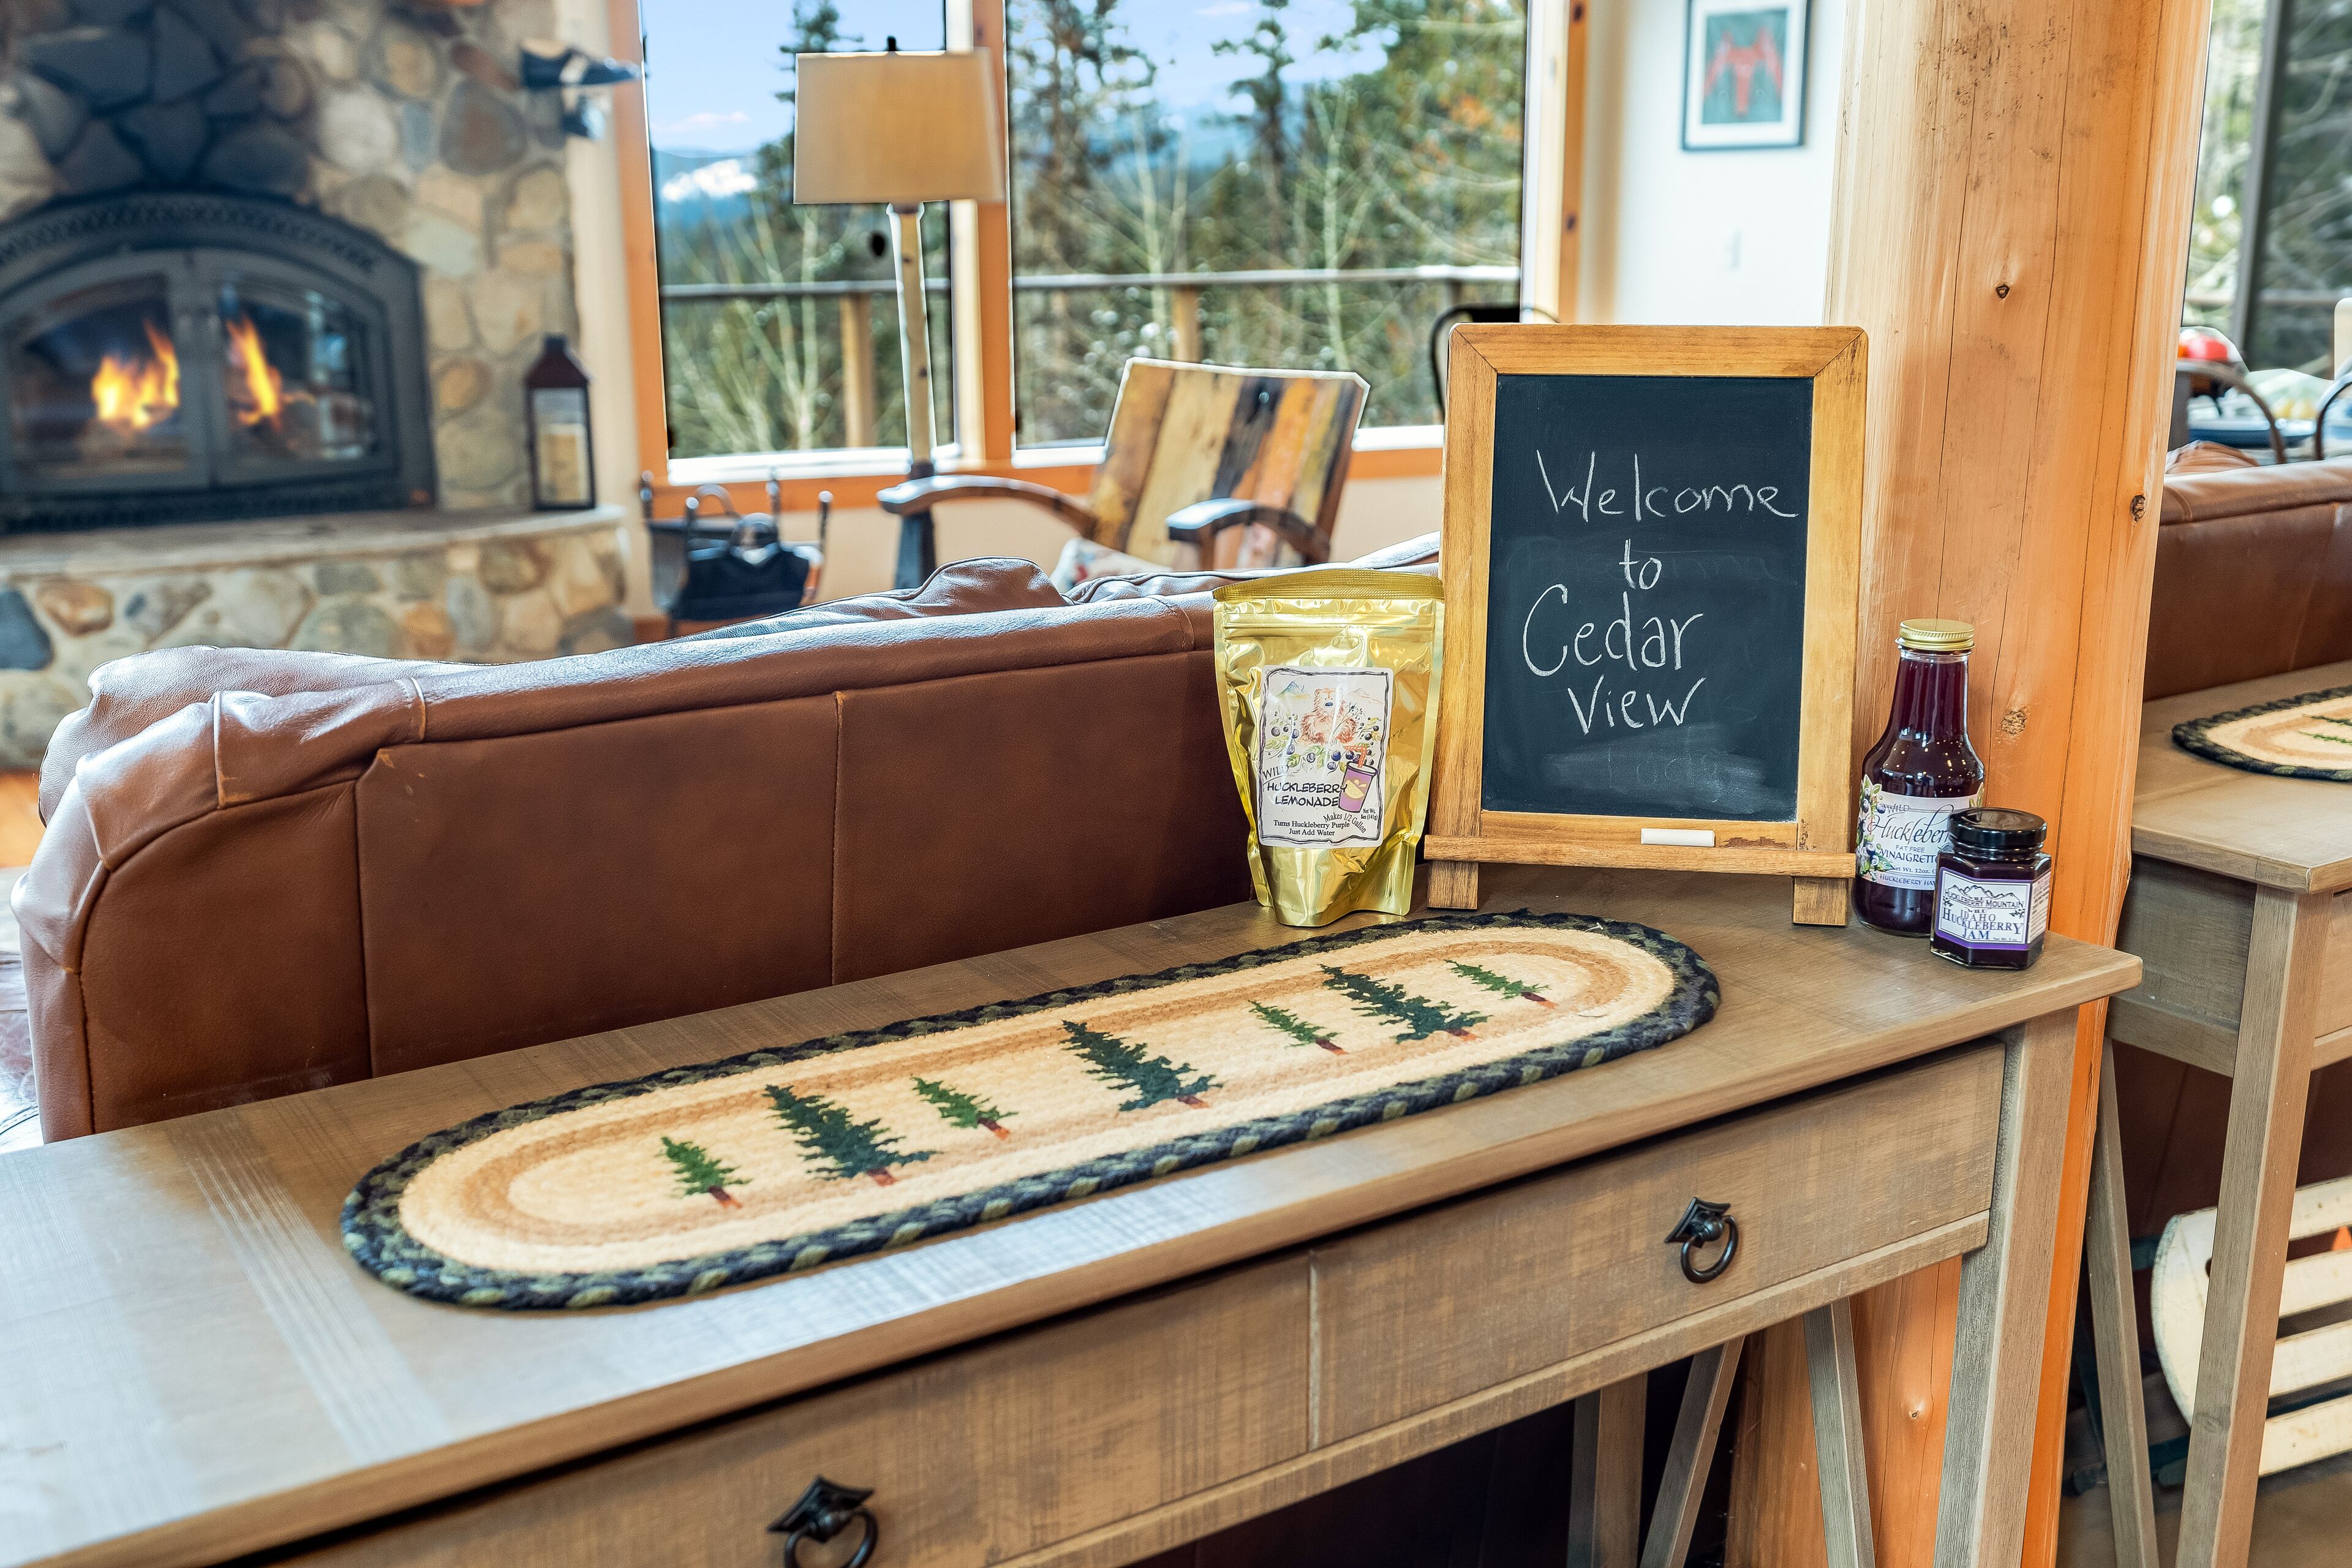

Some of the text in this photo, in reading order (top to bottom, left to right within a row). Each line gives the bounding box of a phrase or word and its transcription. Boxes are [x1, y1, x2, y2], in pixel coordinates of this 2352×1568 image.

[1536, 450, 1799, 522] Welcome
[1618, 538, 1662, 590] to
[1523, 584, 1704, 677] Cedar
[1263, 764, 1289, 781] WILD
[1267, 782, 1348, 794] HUCKLEBERRY
[1275, 795, 1340, 807] LEMONADE
[1888, 804, 1910, 814] WILD
[1291, 821, 1330, 829] Huckleberry
[1331, 821, 1350, 829] Purple
[1323, 812, 1366, 834] Makes 1/2 Gallon
[1879, 873, 1922, 886] HUCKLEBERRY
[1960, 909, 1996, 922] IDAHO
[1962, 928, 1990, 940] JAM
